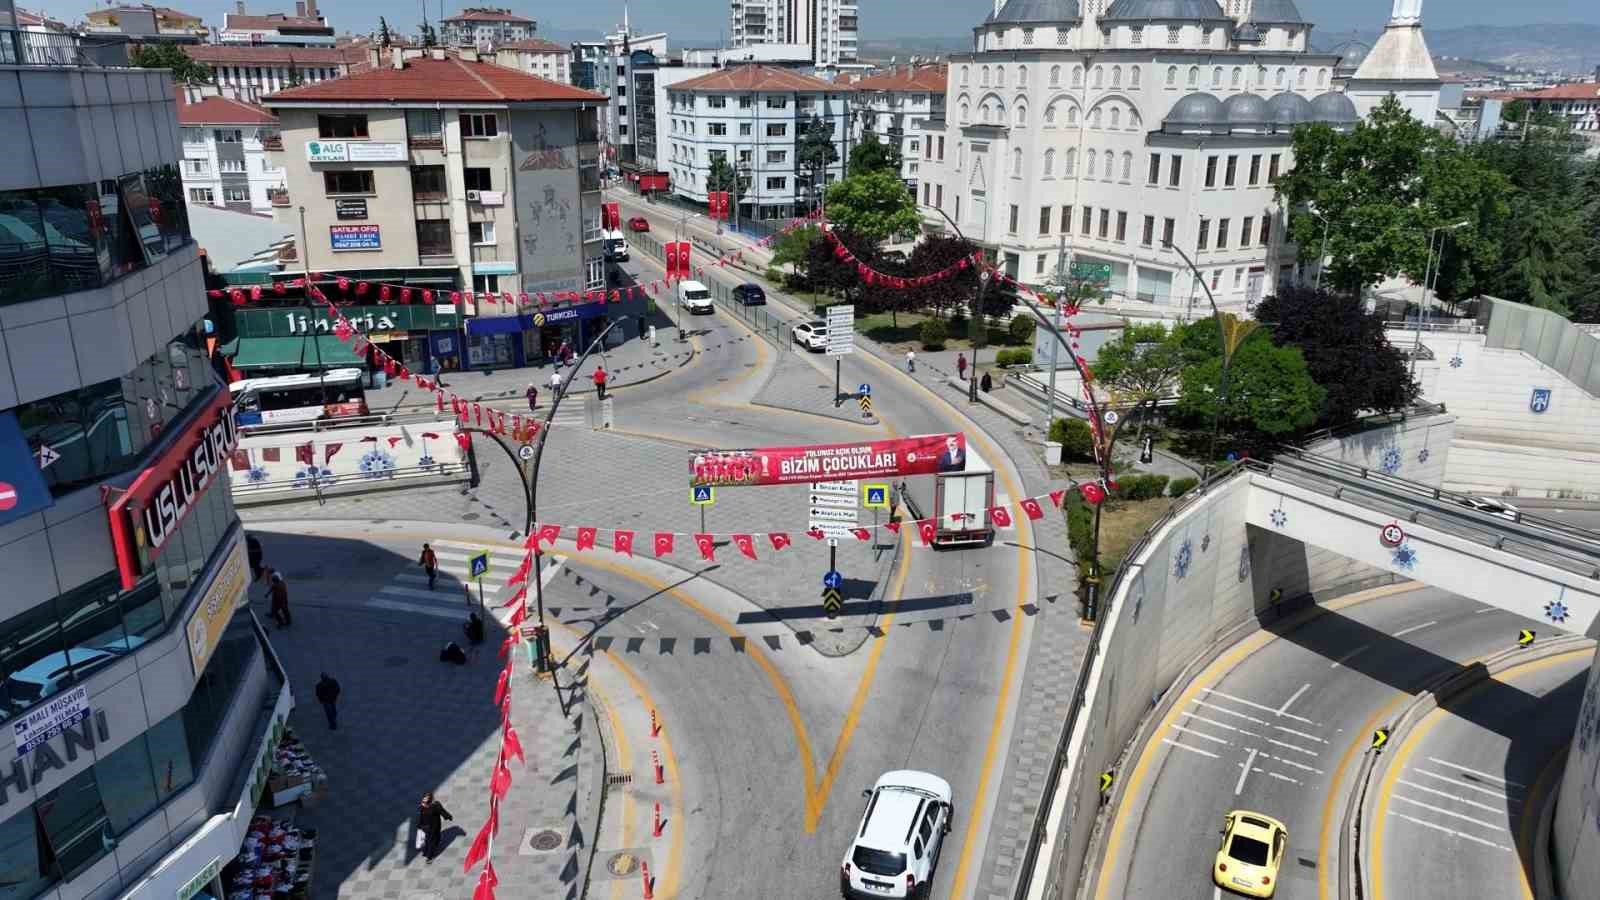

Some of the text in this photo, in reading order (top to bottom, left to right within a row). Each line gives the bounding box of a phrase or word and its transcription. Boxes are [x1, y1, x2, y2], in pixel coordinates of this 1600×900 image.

[323, 143, 344, 153] ALG
[546, 310, 579, 321] TURKCELL
[781, 456, 819, 474] BİZİM
[823, 453, 897, 474] ÇOCUKLAR!
[145, 459, 195, 548] USLU
